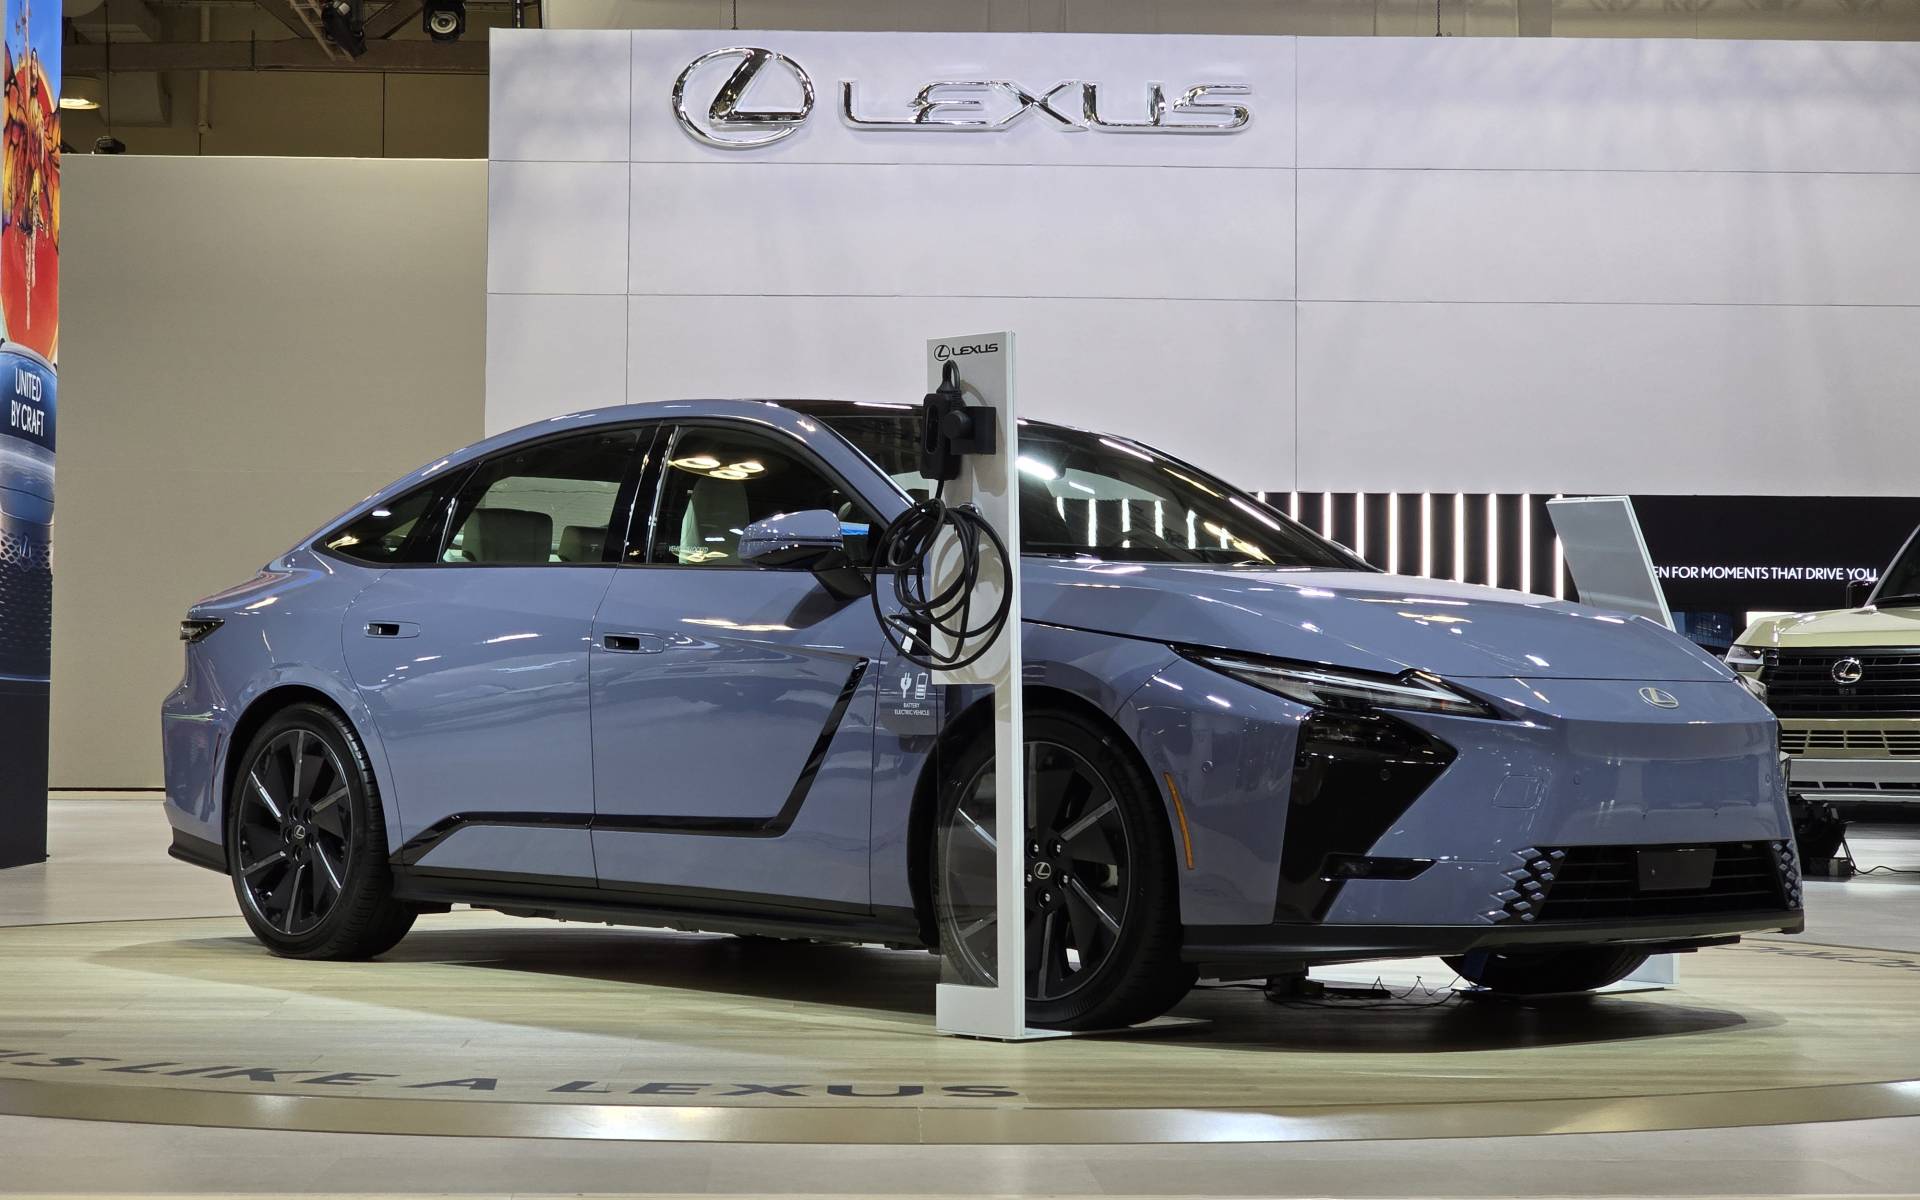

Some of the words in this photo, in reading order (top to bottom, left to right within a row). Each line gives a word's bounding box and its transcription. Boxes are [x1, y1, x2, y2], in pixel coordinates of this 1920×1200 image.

[837, 80, 1252, 132] LEXUS
[952, 343, 998, 356] LEXUS
[15, 367, 42, 402] UNITED
[11, 399, 21, 428] BY
[21, 404, 45, 437] CRAFT
[1671, 566, 1699, 579] FOR
[1701, 566, 1769, 580] MOMENTS
[1771, 567, 1803, 580] THAT
[1805, 567, 1844, 580] DRIVE
[101, 1061, 400, 1085] LIKE
[400, 1077, 498, 1091] A
[547, 1080, 1019, 1097] LEXUS
